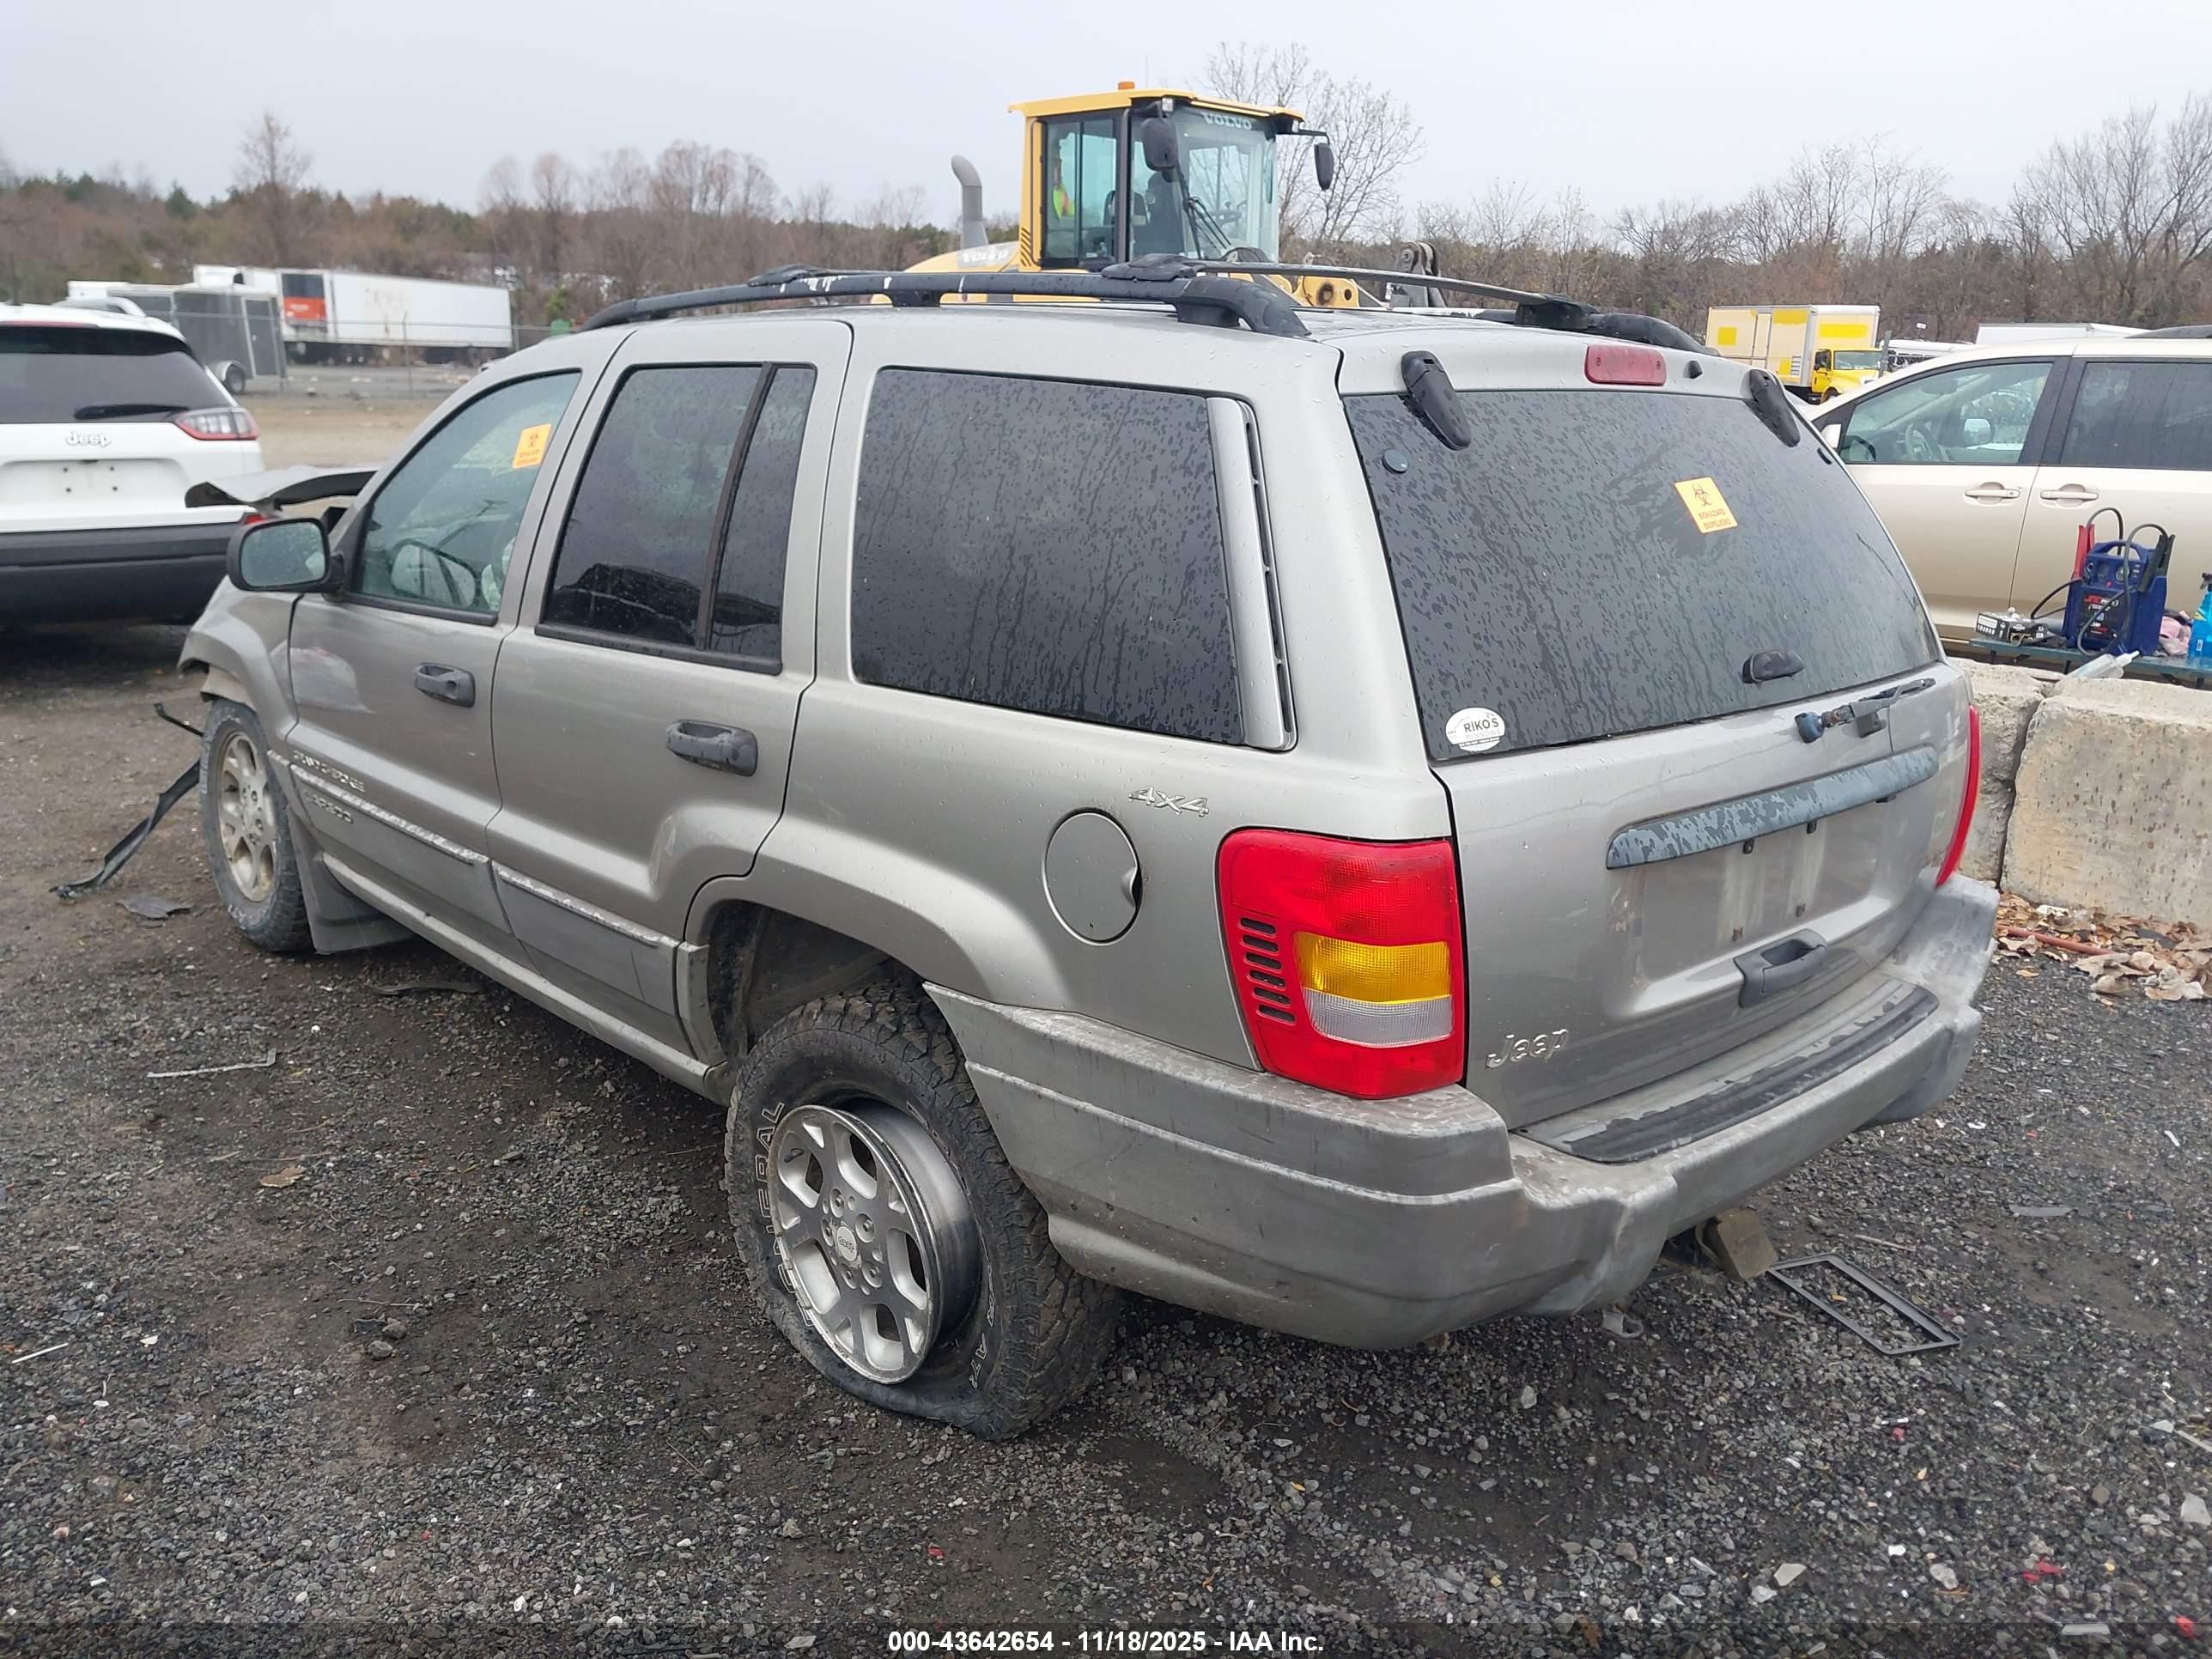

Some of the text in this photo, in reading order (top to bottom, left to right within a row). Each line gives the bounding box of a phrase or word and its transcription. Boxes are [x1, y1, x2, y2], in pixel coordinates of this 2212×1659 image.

[1200, 112, 1252, 131] VOLVO
[65, 431, 112, 447] Jeep
[1463, 714, 1499, 732] RIKO'S
[1486, 1029, 1569, 1068] Jeep
